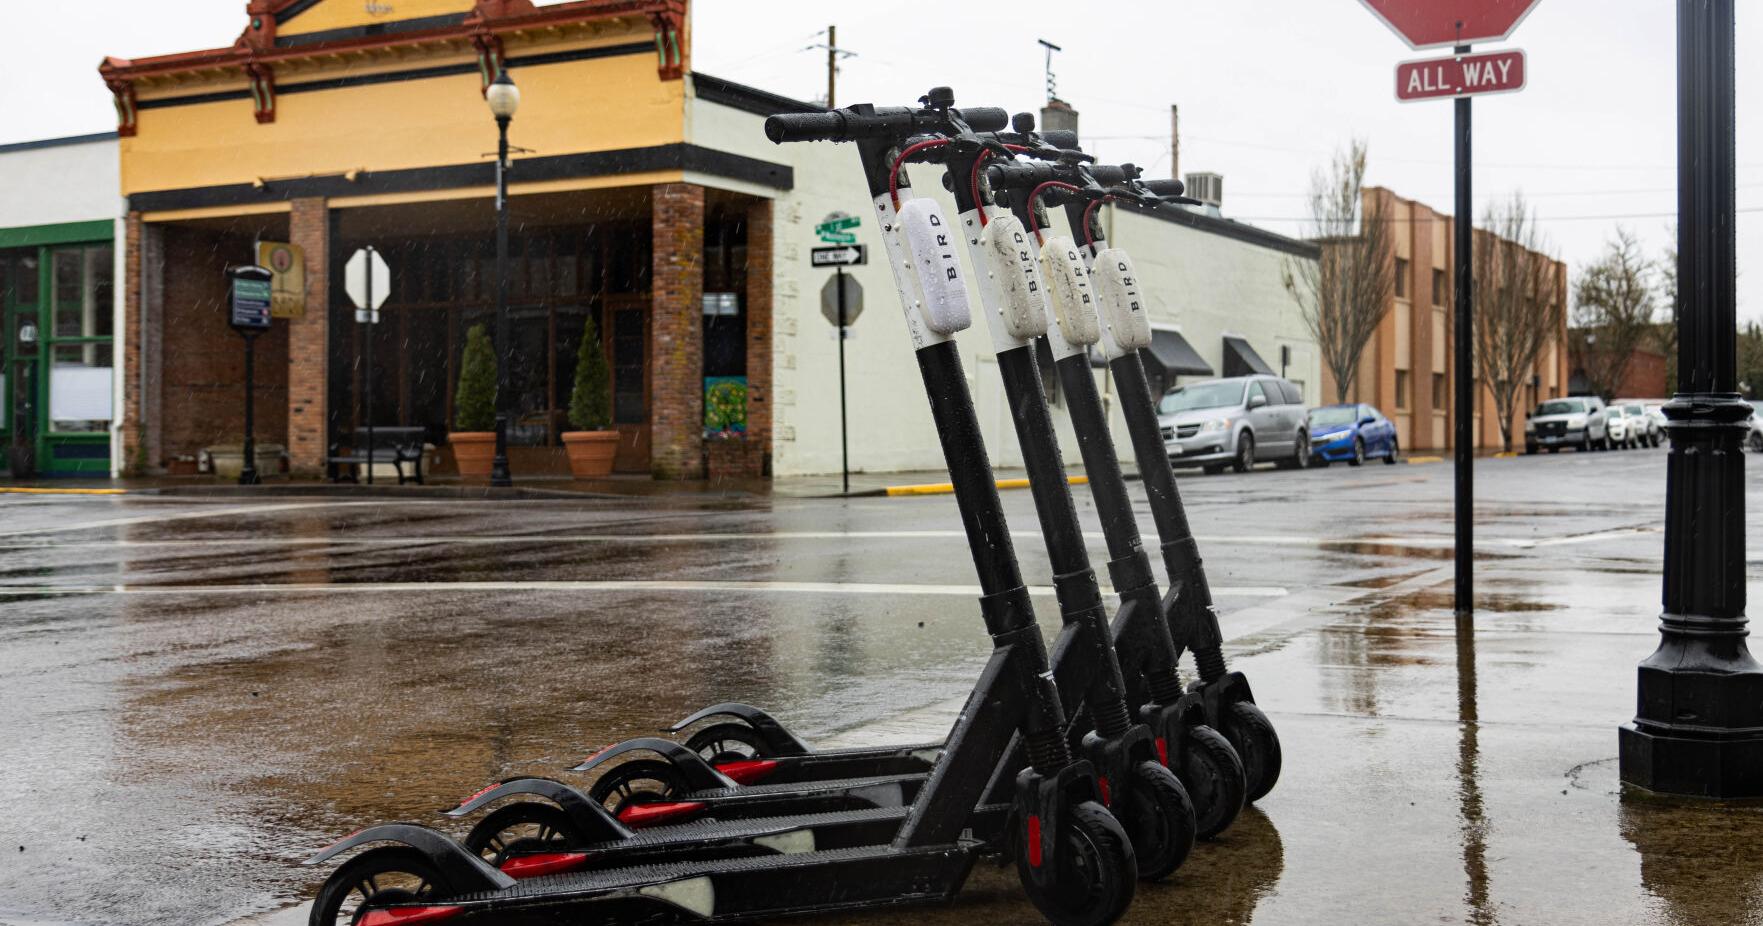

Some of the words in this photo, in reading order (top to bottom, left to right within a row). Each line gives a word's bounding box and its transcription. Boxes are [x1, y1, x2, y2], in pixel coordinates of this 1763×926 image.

[1407, 65, 1451, 93] ALL
[1462, 58, 1512, 87] WAY
[929, 214, 957, 282] BIRD
[1014, 231, 1037, 293] BIRD
[1068, 250, 1091, 305] BIRD
[1118, 261, 1140, 312] BIRD
